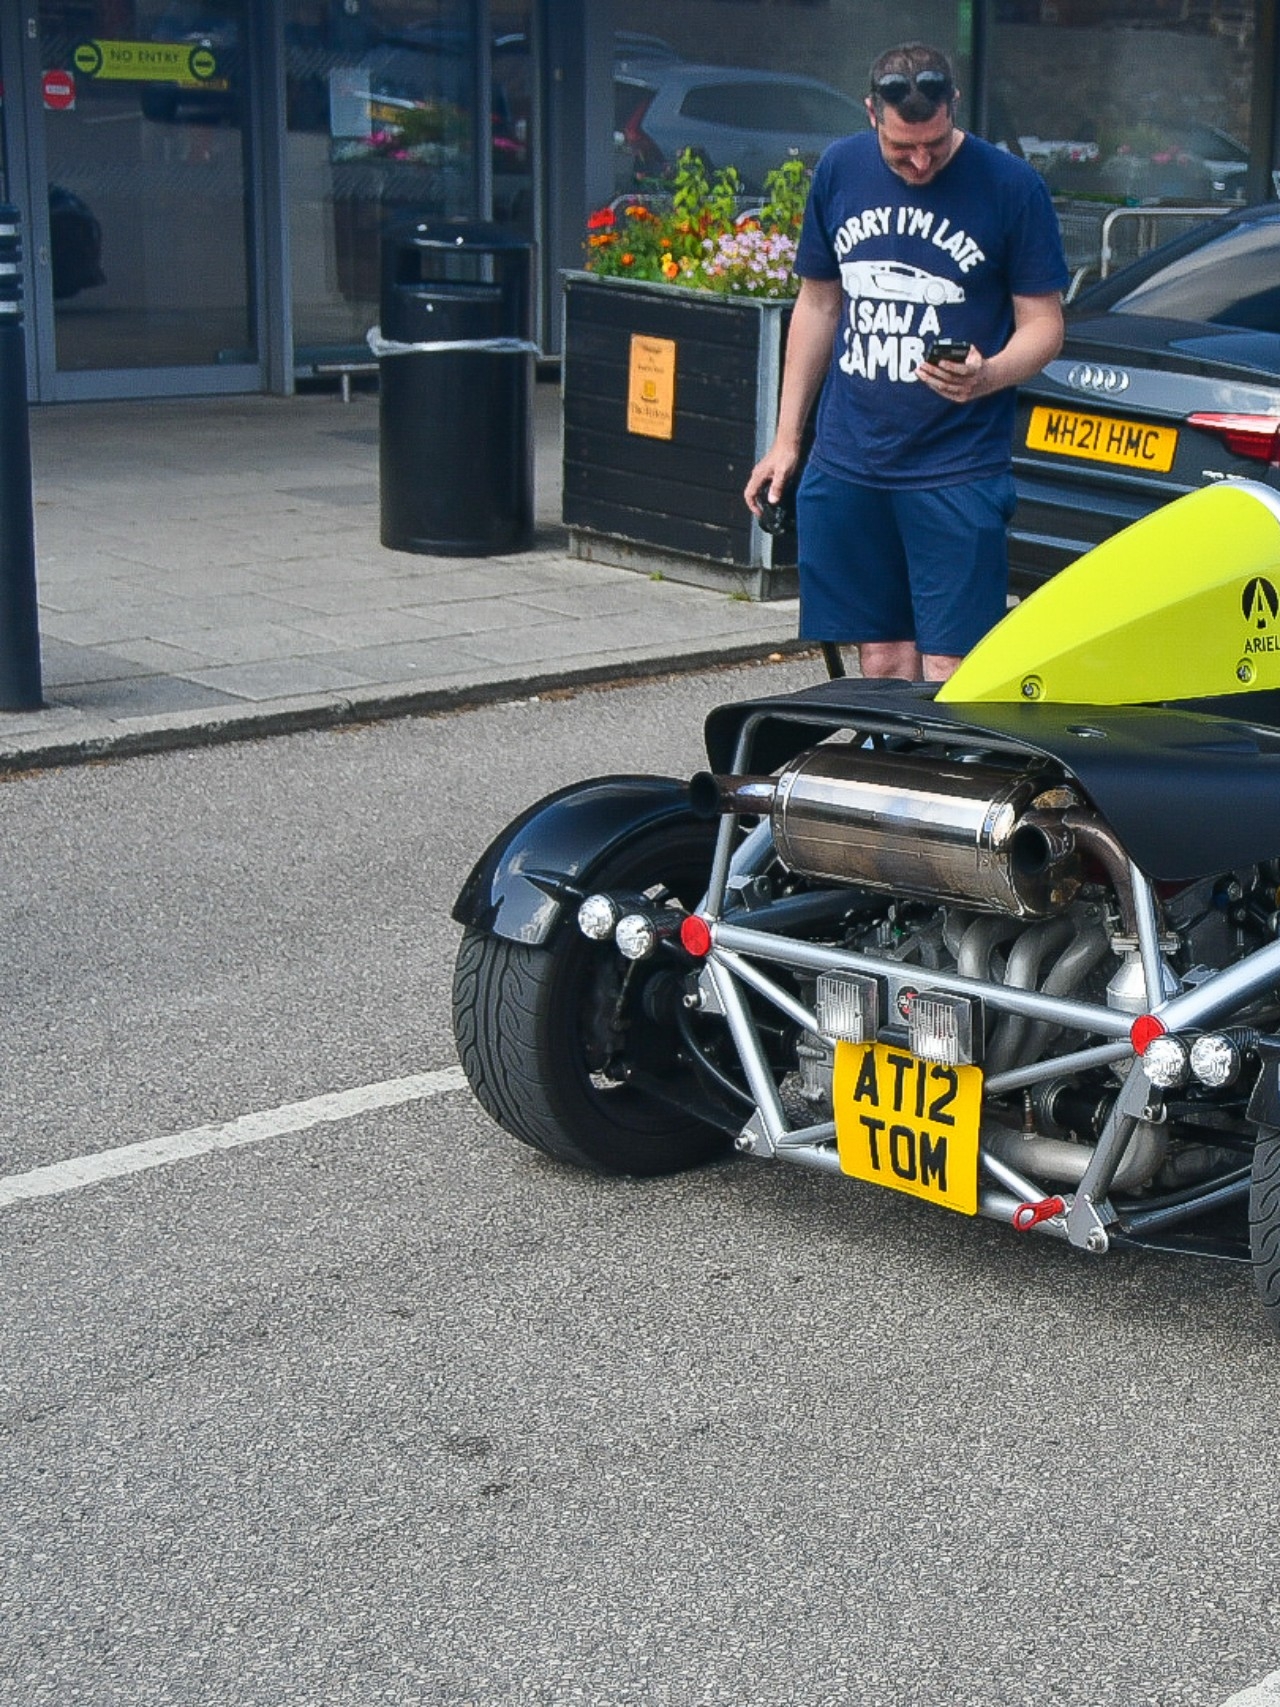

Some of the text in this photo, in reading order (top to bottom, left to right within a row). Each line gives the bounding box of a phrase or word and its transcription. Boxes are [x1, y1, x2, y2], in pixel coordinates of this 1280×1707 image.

[110, 50, 181, 64] NO ENTRY
[897, 206, 934, 239] I'M
[932, 218, 986, 273] LATE
[858, 300, 914, 334] SAW
[918, 304, 941, 337] A
[839, 327, 928, 382] LAMB
[1044, 413, 1160, 460] MH21 HMC
[853, 1050, 959, 1127] AT12
[859, 1114, 948, 1193] TOM
